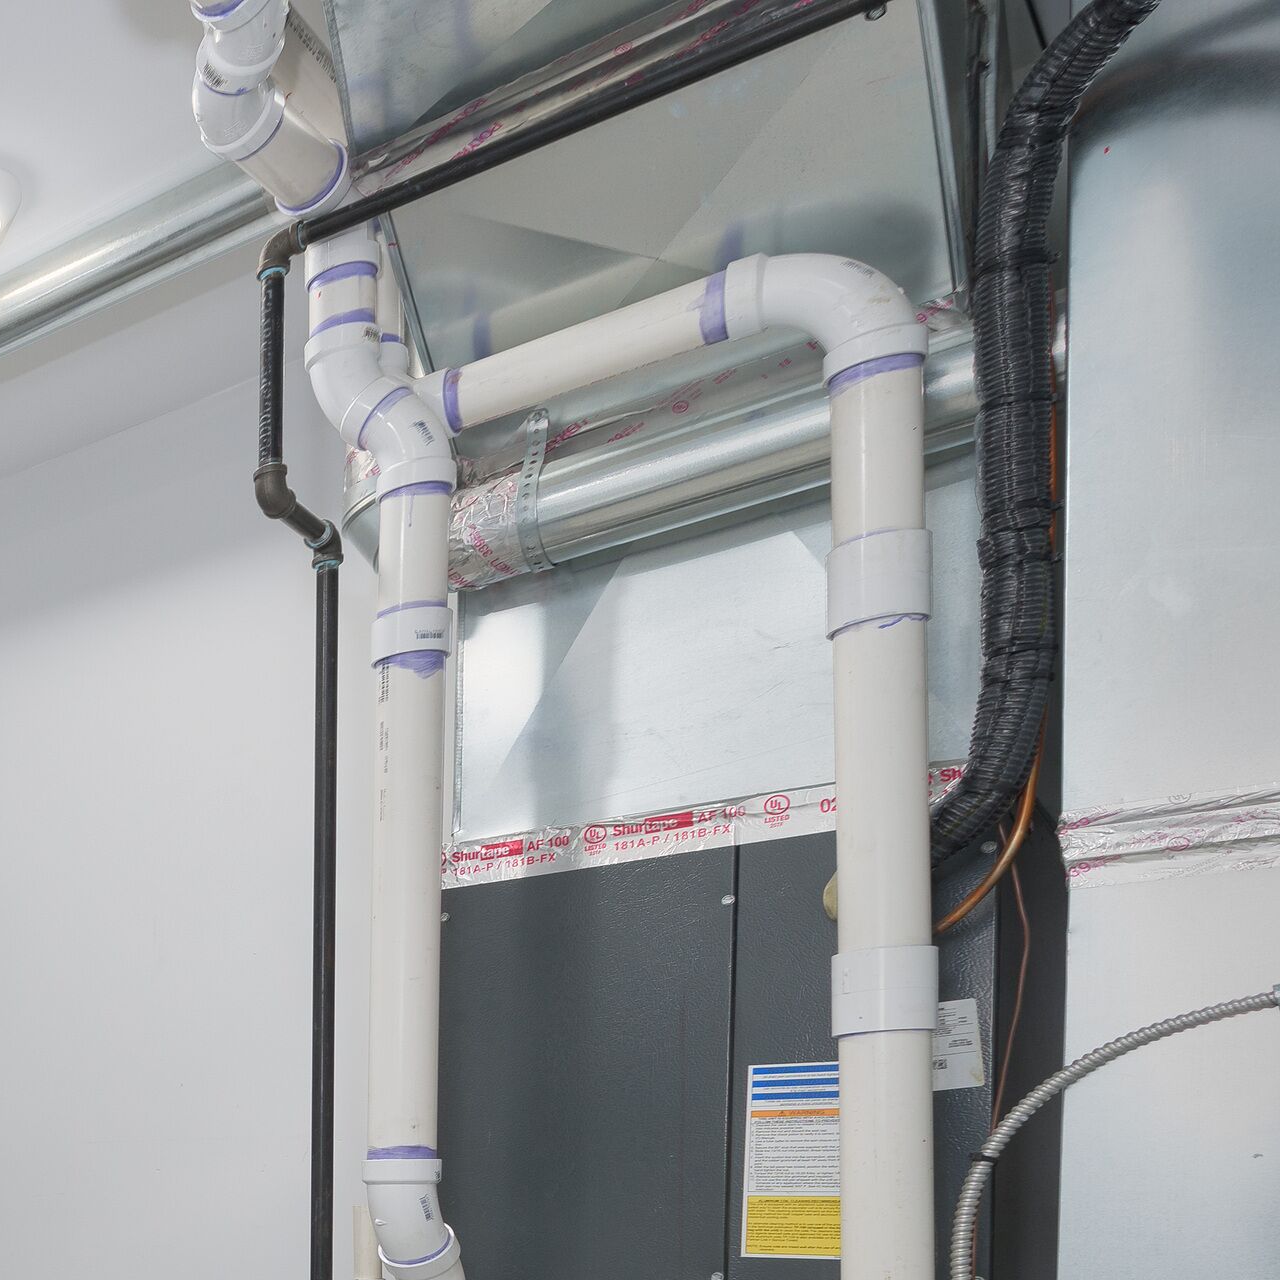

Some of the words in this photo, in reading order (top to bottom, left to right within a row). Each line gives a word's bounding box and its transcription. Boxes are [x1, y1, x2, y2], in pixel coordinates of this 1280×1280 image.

[612, 817, 678, 838] Shurtape
[698, 812, 719, 824] AF
[722, 806, 745, 820] 100
[764, 815, 789, 823] LISTED
[452, 845, 509, 863] Shurtape
[527, 840, 544, 852] AF
[548, 835, 569, 849] 100
[584, 844, 606, 852] LISTED
[614, 836, 659, 851] 181A-P
[675, 824, 733, 842] 181B-FX
[453, 863, 494, 876] 181A-P
[505, 852, 556, 868] 181B-FX
